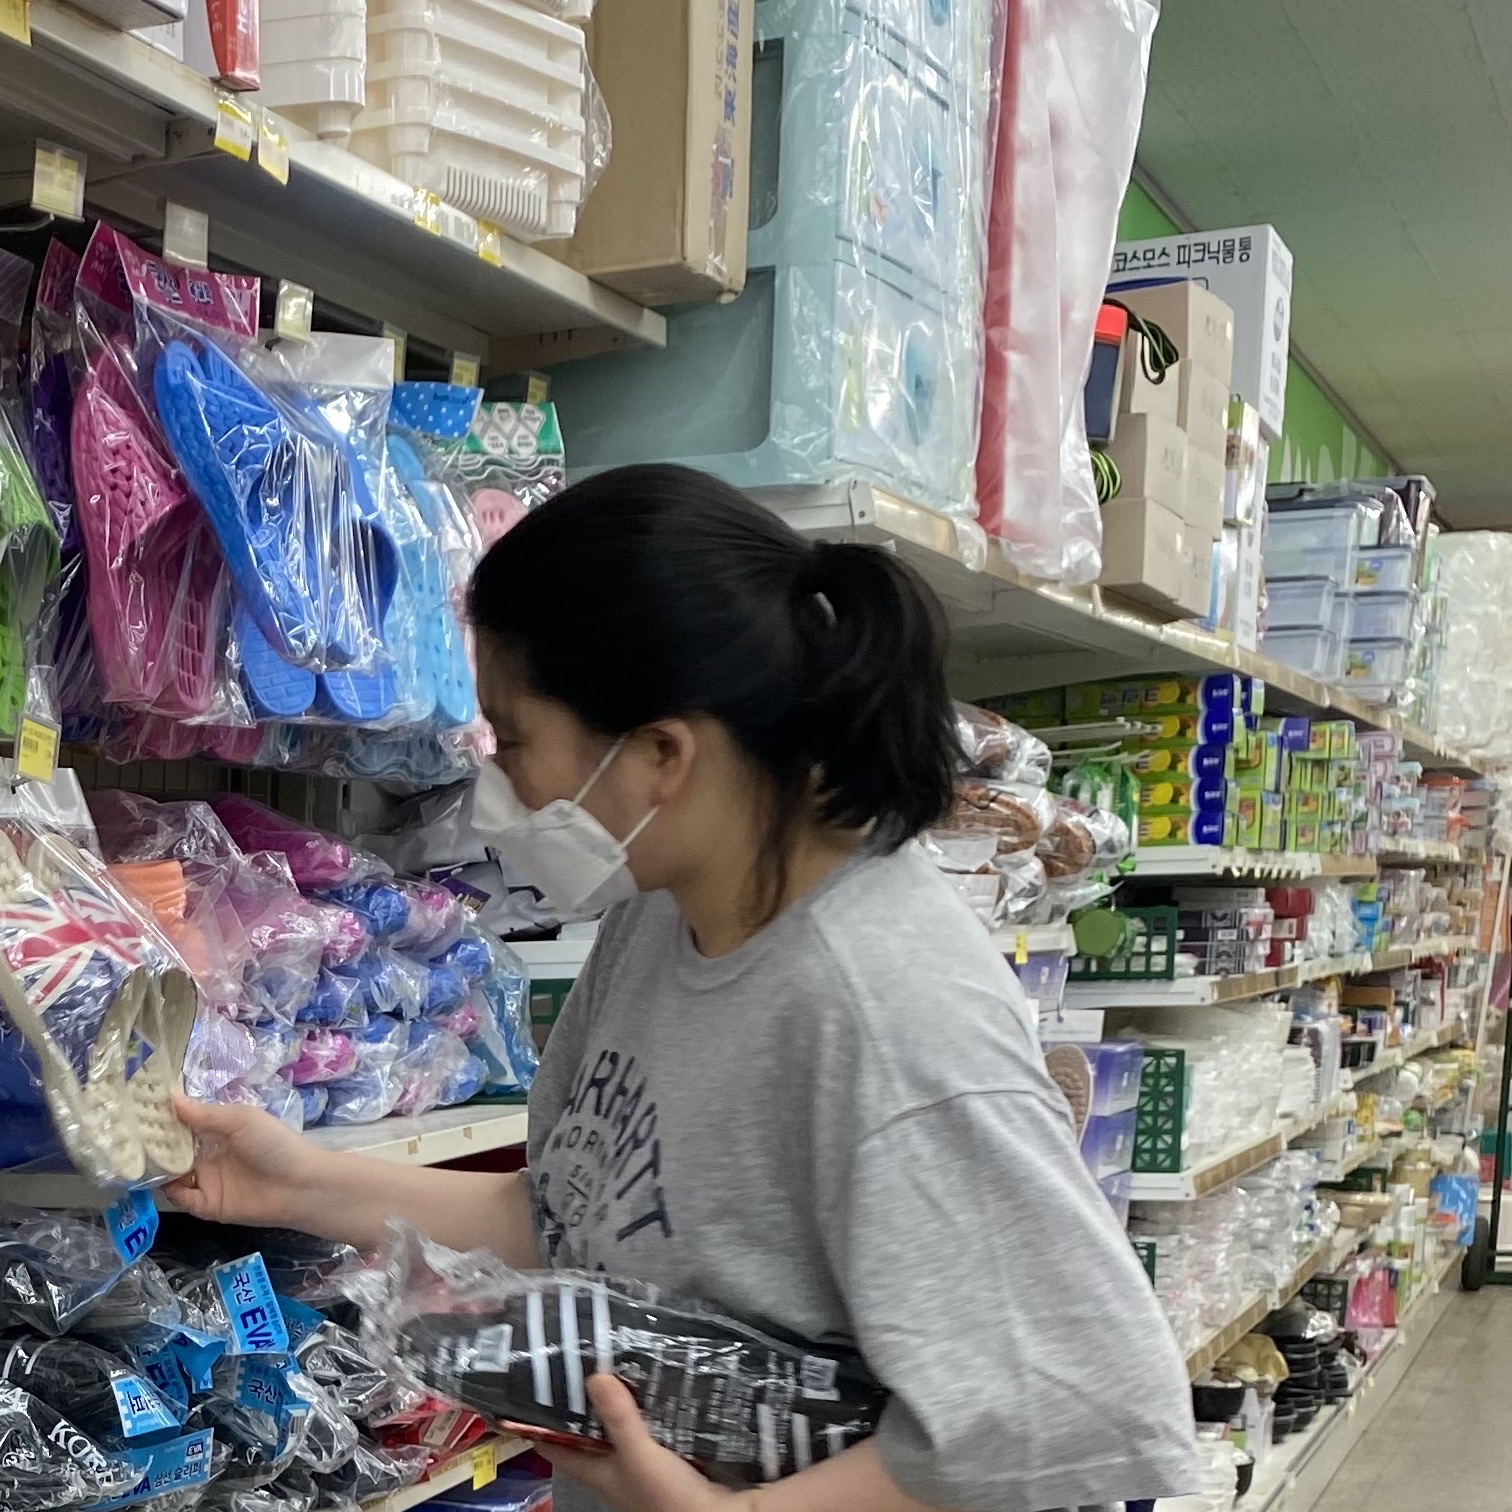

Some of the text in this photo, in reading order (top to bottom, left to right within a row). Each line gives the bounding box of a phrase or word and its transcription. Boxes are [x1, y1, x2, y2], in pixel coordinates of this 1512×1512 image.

[1113, 235, 1253, 274] 코스모스 피크닉물통
[239, 1305, 277, 1351] EVA
